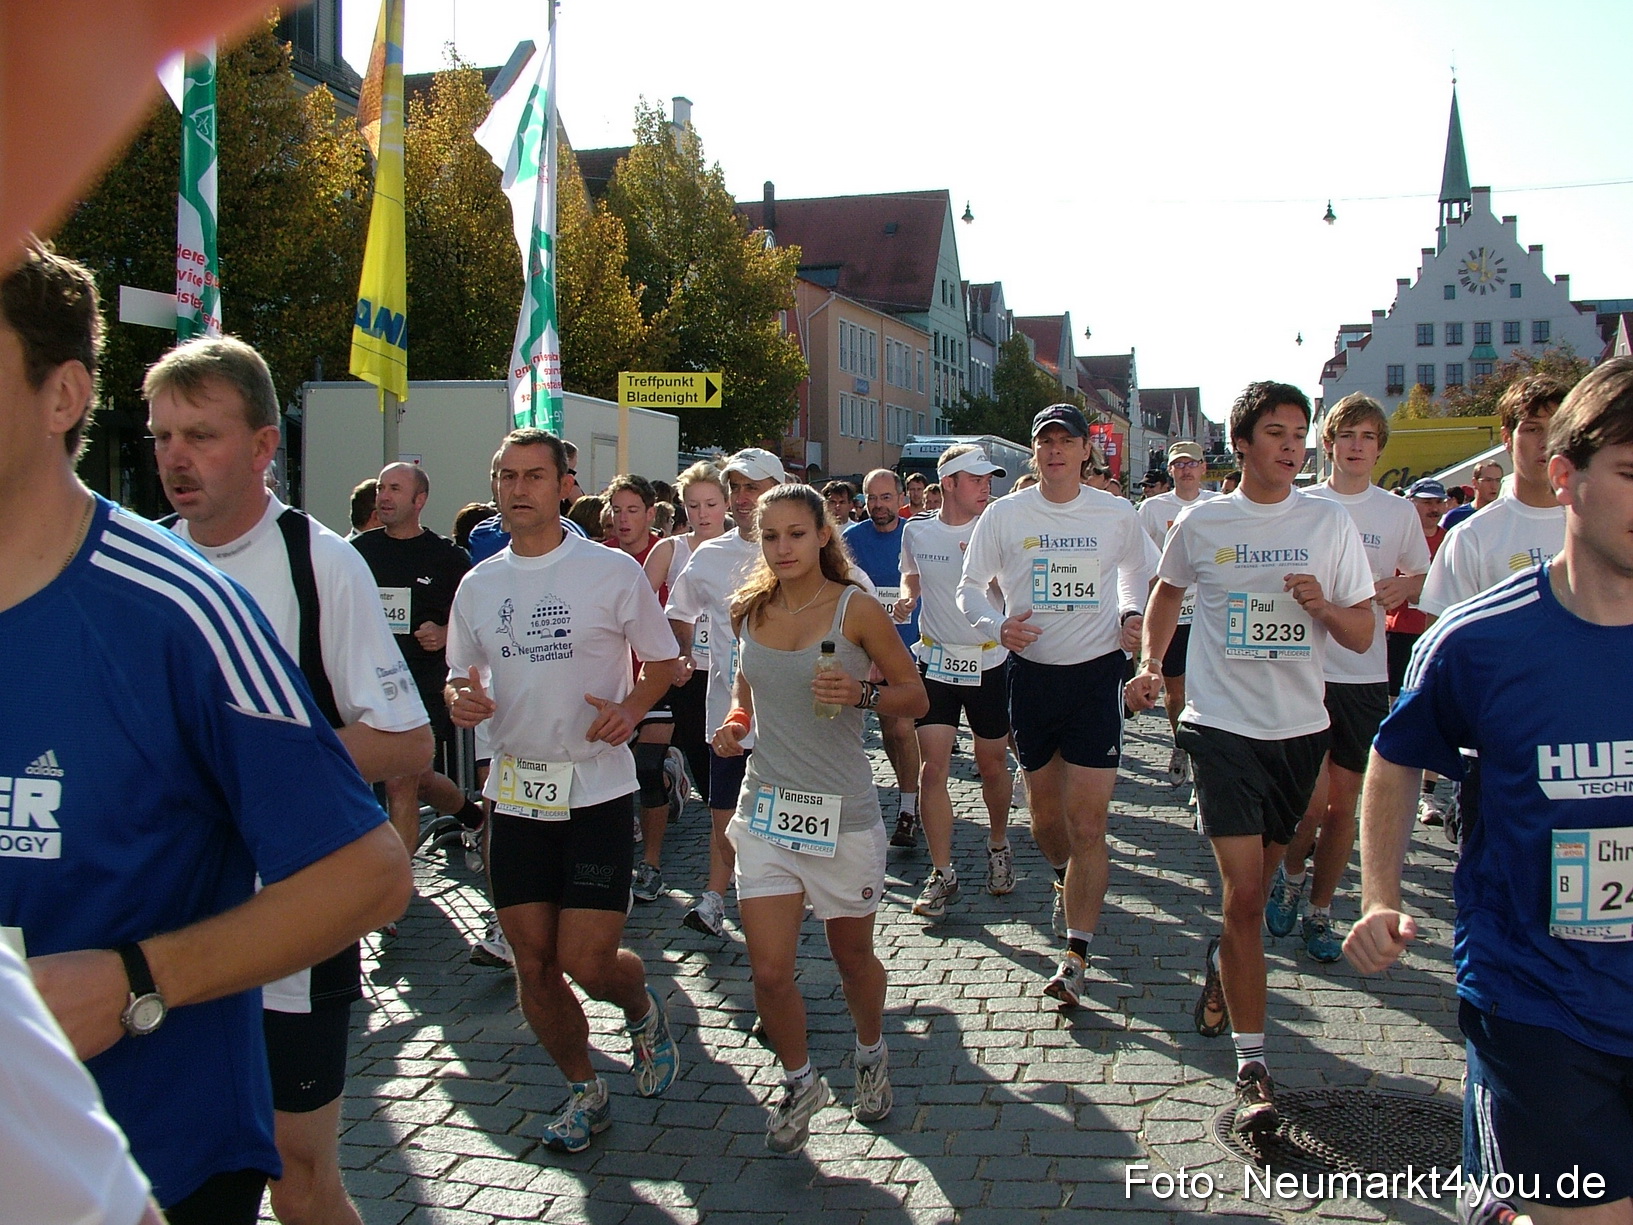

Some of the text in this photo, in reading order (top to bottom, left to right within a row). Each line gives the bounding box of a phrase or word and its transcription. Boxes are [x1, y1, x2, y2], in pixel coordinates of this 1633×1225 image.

[627, 375, 694, 389] Treffpunkt
[627, 391, 698, 405] Bladenight
[1039, 534, 1098, 548] HÄRTEIS
[1235, 544, 1309, 564] HÄRTEIS
[1051, 562, 1078, 574] Armin
[878, 590, 900, 598] Helmut
[1052, 582, 1095, 598] 3154
[1250, 599, 1275, 612] Paul
[531, 617, 571, 628] 16.09.2007
[1230, 617, 1237, 628] B
[1252, 623, 1306, 641] 3239
[501, 641, 573, 658] 8. Neumarkter
[530, 649, 574, 662] Stadtlauf
[944, 657, 978, 673] 3526
[25, 766, 64, 777] adidas
[523, 780, 558, 802] 873
[778, 787, 823, 805] Vanessa
[757, 802, 764, 813] B
[777, 811, 830, 837] 3261
[1559, 875, 1569, 893] B
